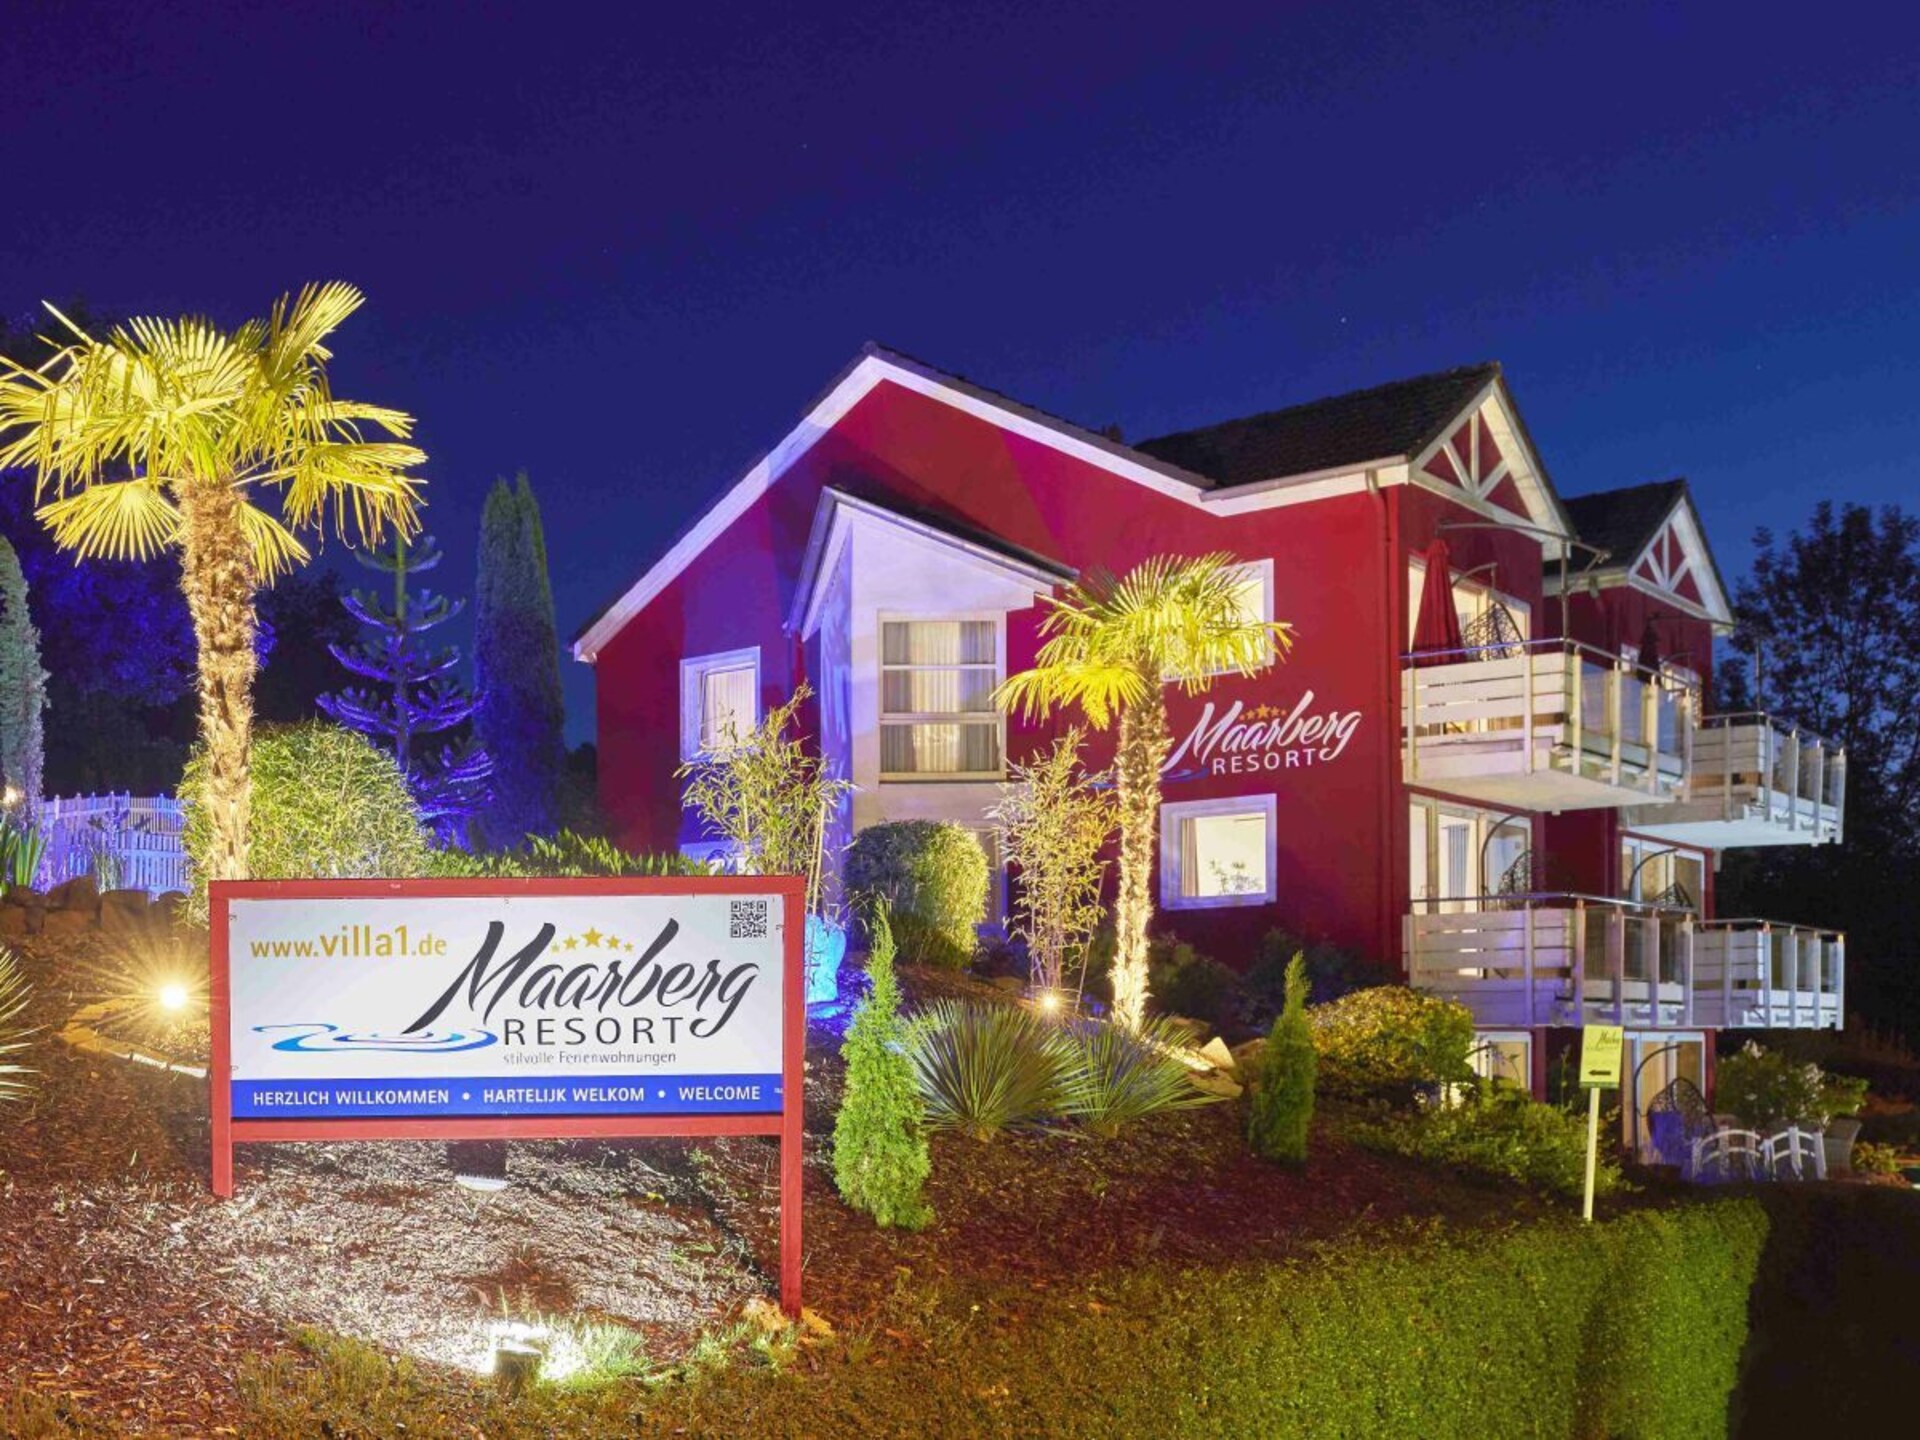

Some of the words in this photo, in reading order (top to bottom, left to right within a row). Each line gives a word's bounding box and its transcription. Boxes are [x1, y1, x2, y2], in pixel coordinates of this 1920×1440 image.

[1159, 690, 1362, 772] Maarberg
[1212, 748, 1317, 775] RESORT
[250, 924, 448, 958] www.villa1.de
[401, 918, 760, 1038] Maarberg
[503, 1016, 684, 1046] RESORT
[503, 1051, 555, 1065] stilvolle
[558, 1049, 677, 1067] Ferienwohnungen
[253, 1090, 329, 1106] HERZLICH
[335, 1089, 450, 1105] WILLKOMMEN
[483, 1088, 567, 1104] HARTELIJK
[573, 1087, 645, 1102] WELKOM
[678, 1085, 761, 1101] WELCOME
